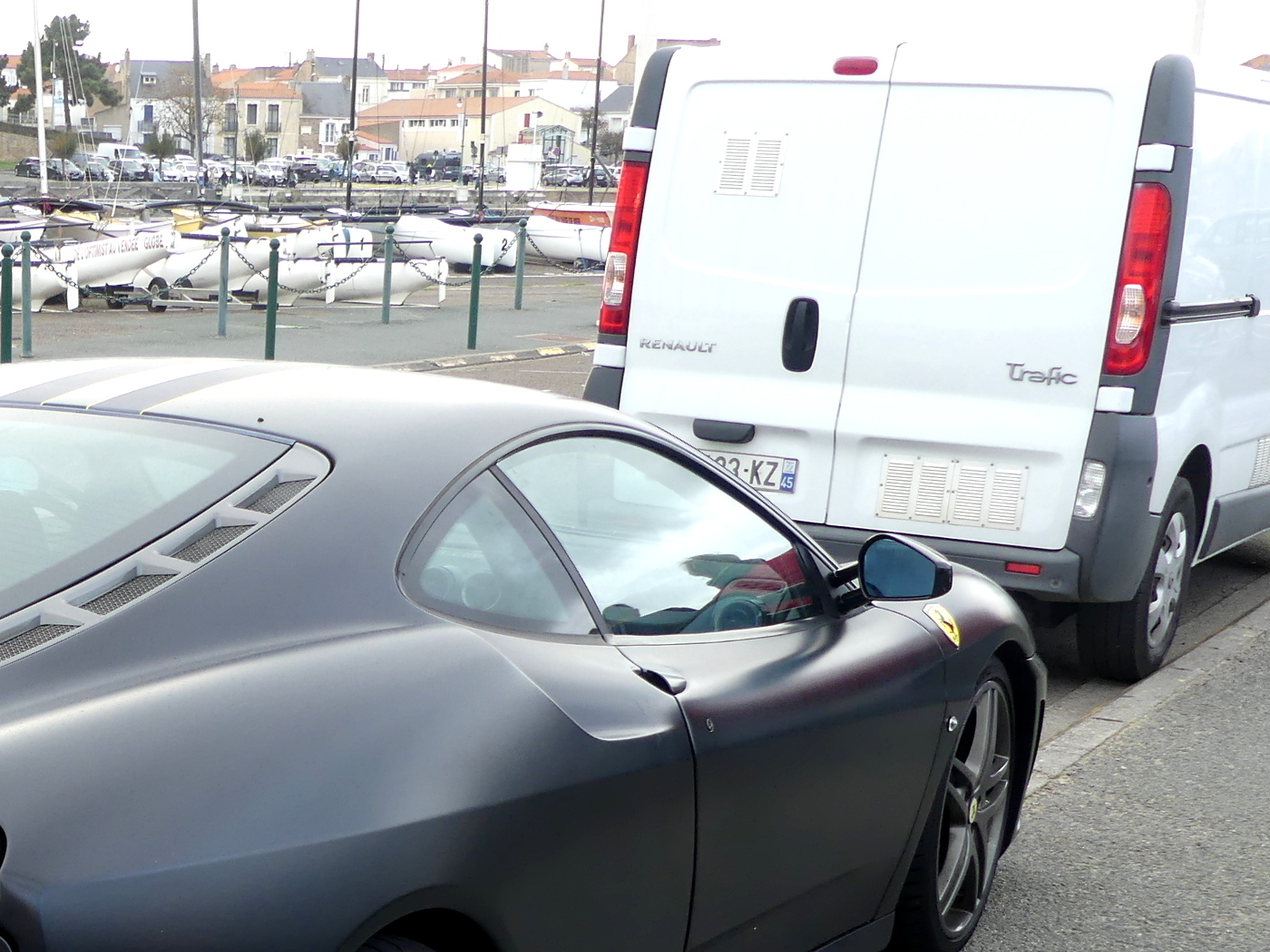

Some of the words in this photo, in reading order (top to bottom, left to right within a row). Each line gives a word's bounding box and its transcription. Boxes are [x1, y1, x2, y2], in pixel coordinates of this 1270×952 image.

[143, 234, 164, 250] GLOBE
[639, 338, 717, 354] RENAULT
[1006, 361, 1079, 386] Trafic
[780, 476, 793, 489] 45
